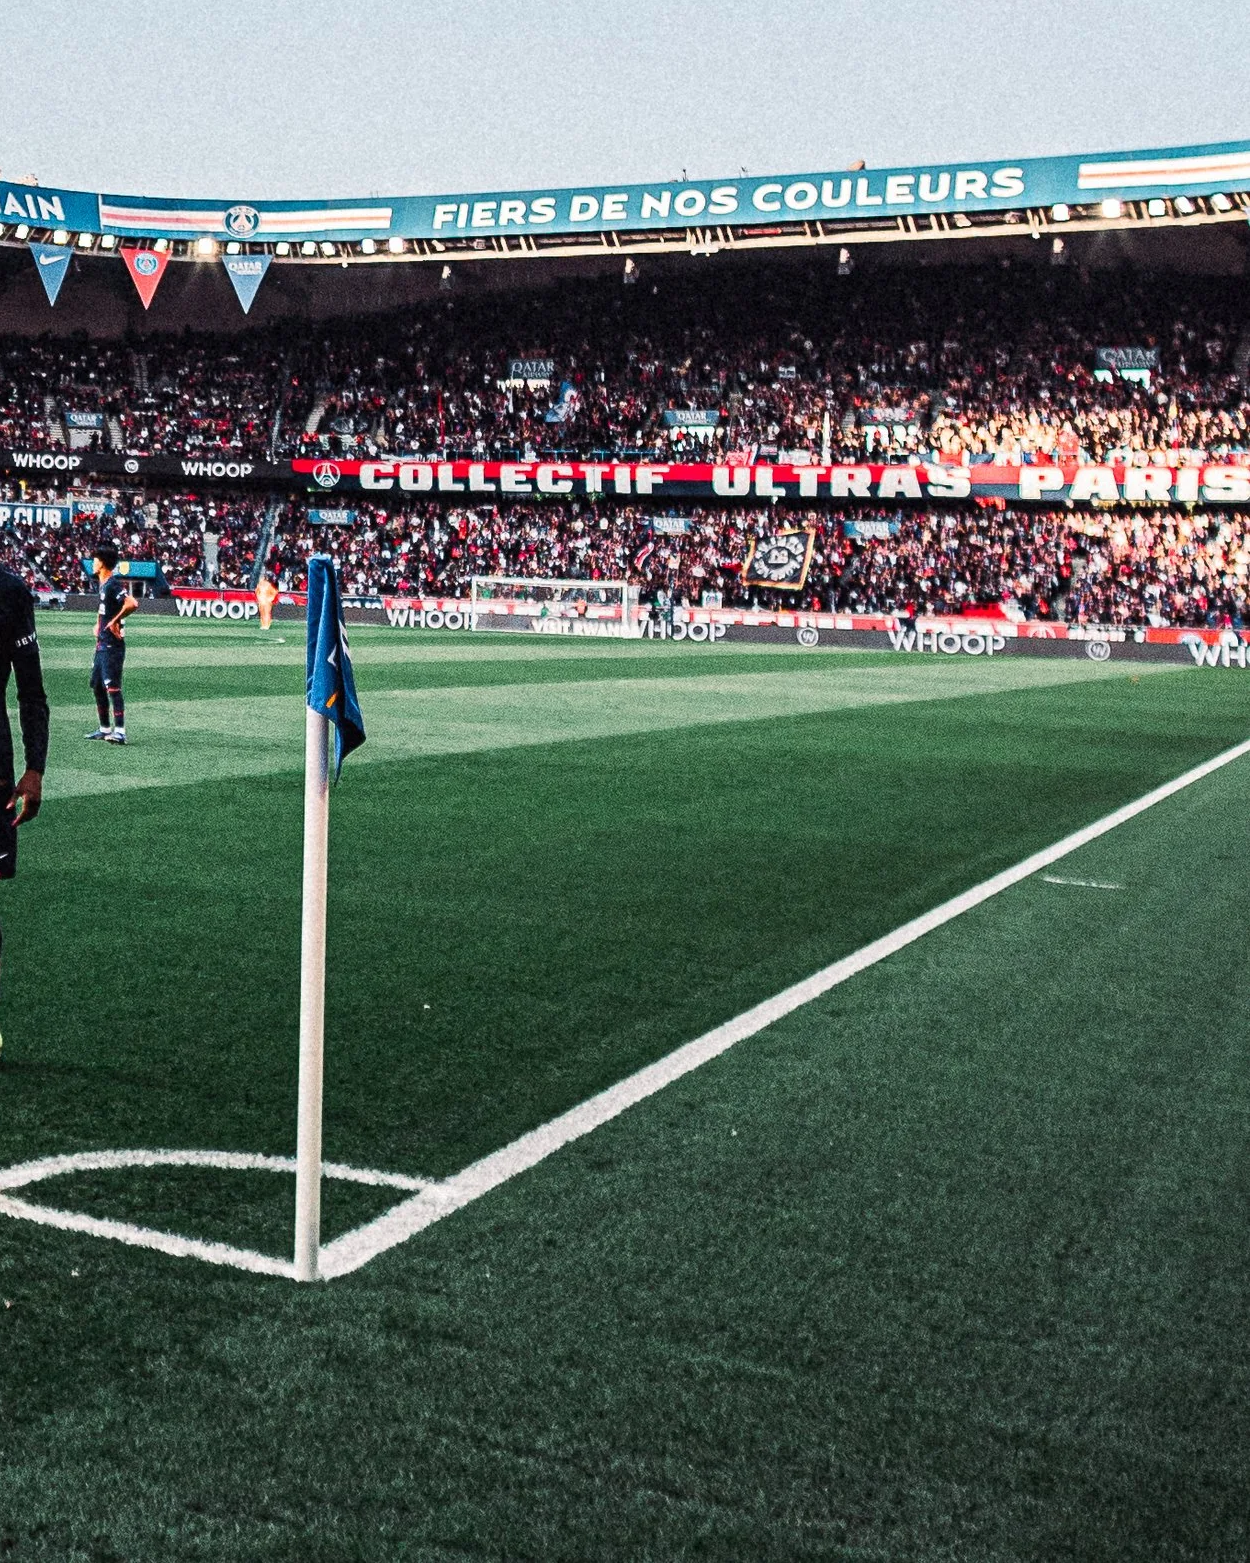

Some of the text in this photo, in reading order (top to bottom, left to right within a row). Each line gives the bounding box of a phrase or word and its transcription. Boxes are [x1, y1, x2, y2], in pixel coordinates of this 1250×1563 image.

[432, 167, 1025, 230] FIERS DE NOS COULEURS
[512, 361, 554, 374] QATAR
[12, 452, 81, 470] WHOOP
[181, 461, 252, 478] WHOOP
[359, 462, 1250, 501] COLLECTIF ULTRAS PARIS
[176, 598, 258, 620] WHOOP
[638, 620, 727, 642] HOOP
[888, 625, 1006, 655] WHOOP
[1186, 637, 1250, 668] WH
